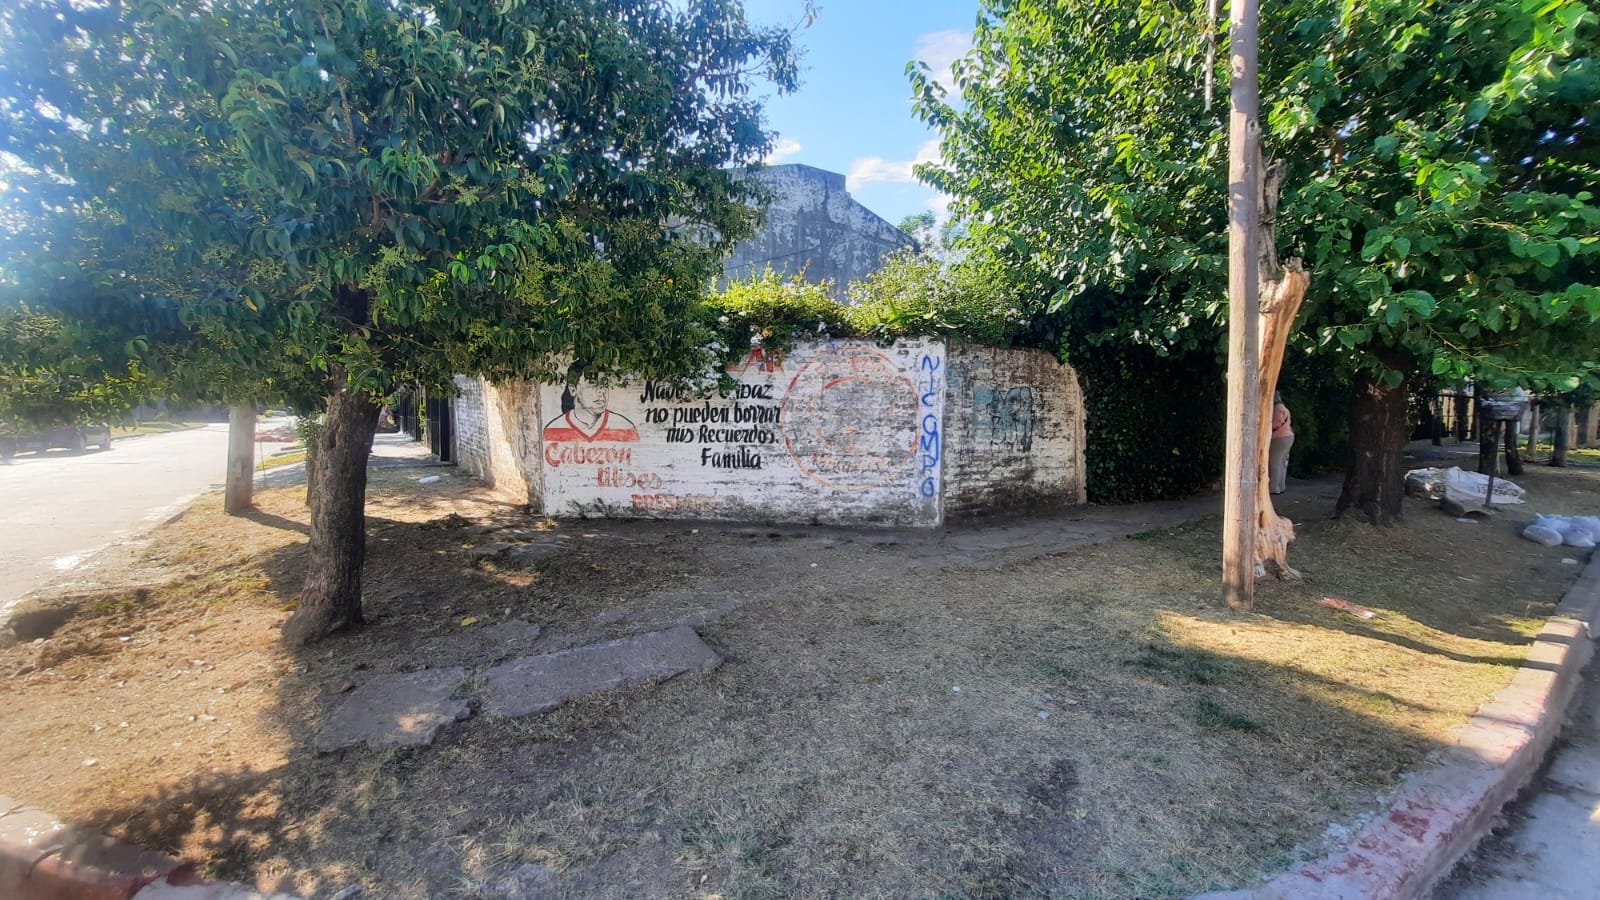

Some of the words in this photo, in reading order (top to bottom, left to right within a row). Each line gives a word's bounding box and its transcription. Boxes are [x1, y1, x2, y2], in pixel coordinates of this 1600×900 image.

[640, 379, 687, 403] Nadi
[645, 407, 669, 424] no
[673, 401, 729, 427] pueden
[734, 401, 781, 424] borrar
[666, 427, 694, 444] mis
[700, 447, 761, 470] Familia
